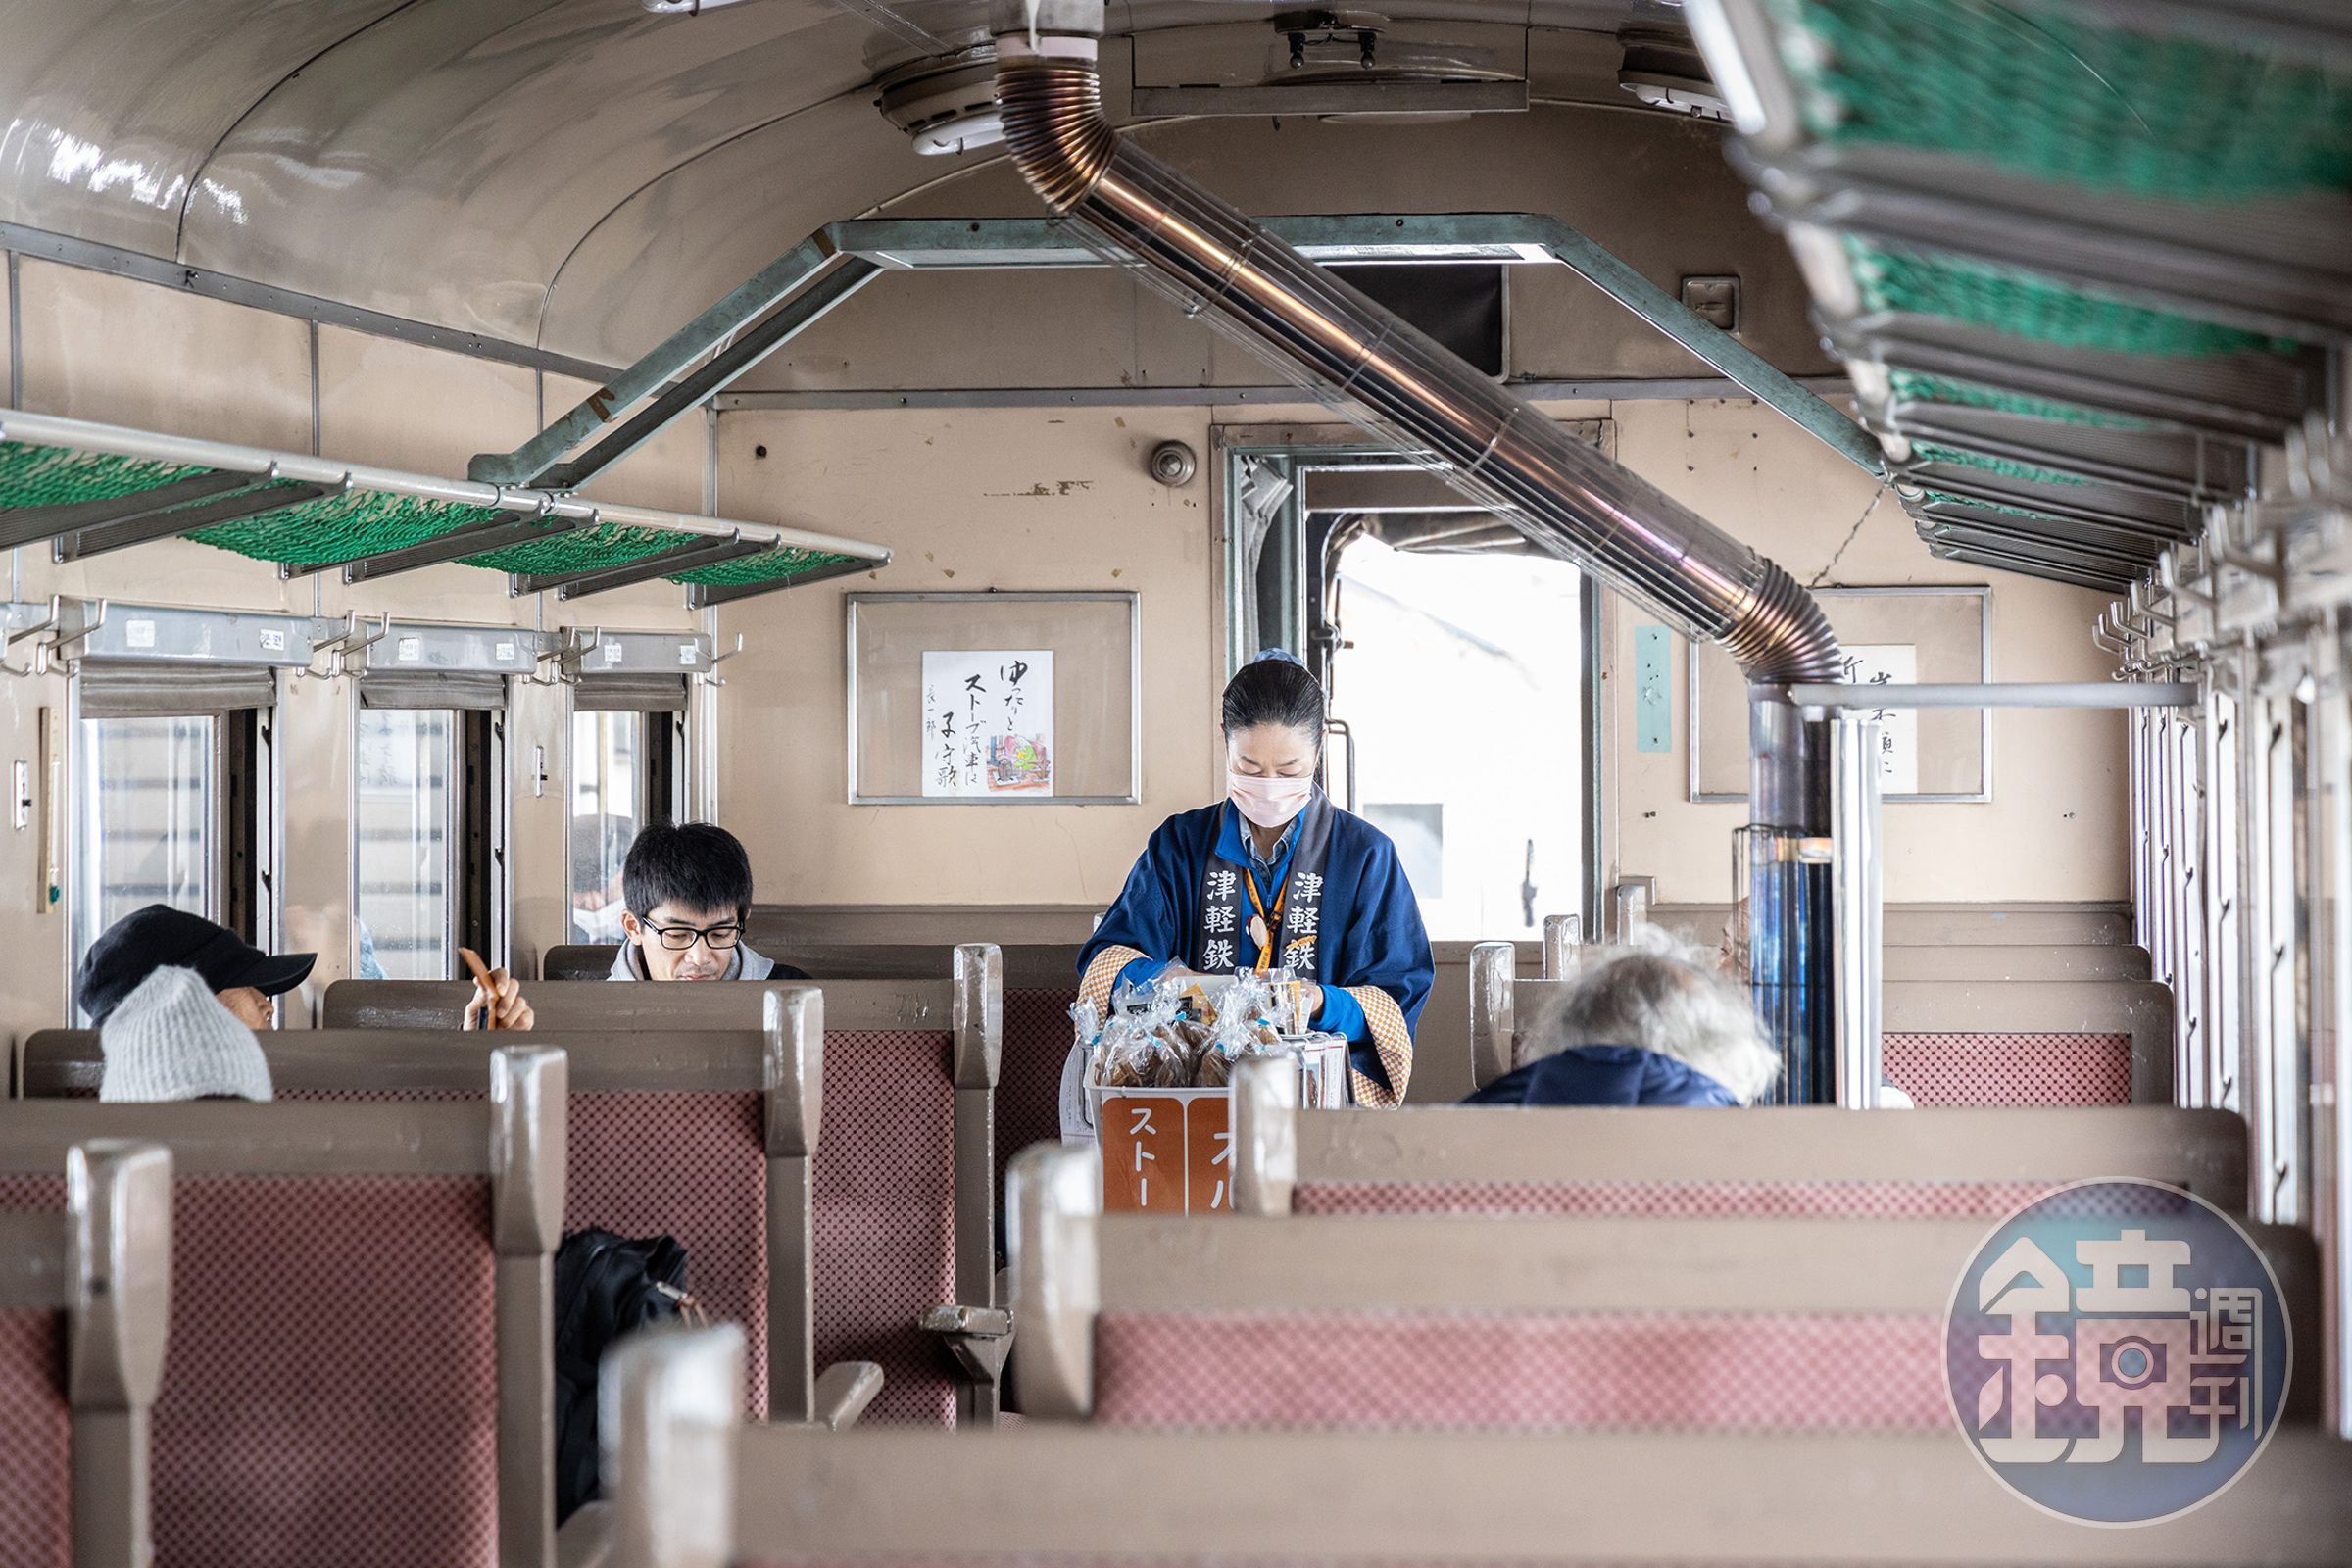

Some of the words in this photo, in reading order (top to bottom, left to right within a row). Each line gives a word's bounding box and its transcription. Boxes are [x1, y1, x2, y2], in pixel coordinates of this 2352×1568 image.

[1000, 660, 1029, 732] ゆったりと
[1201, 870, 1237, 971] 津軽鉄
